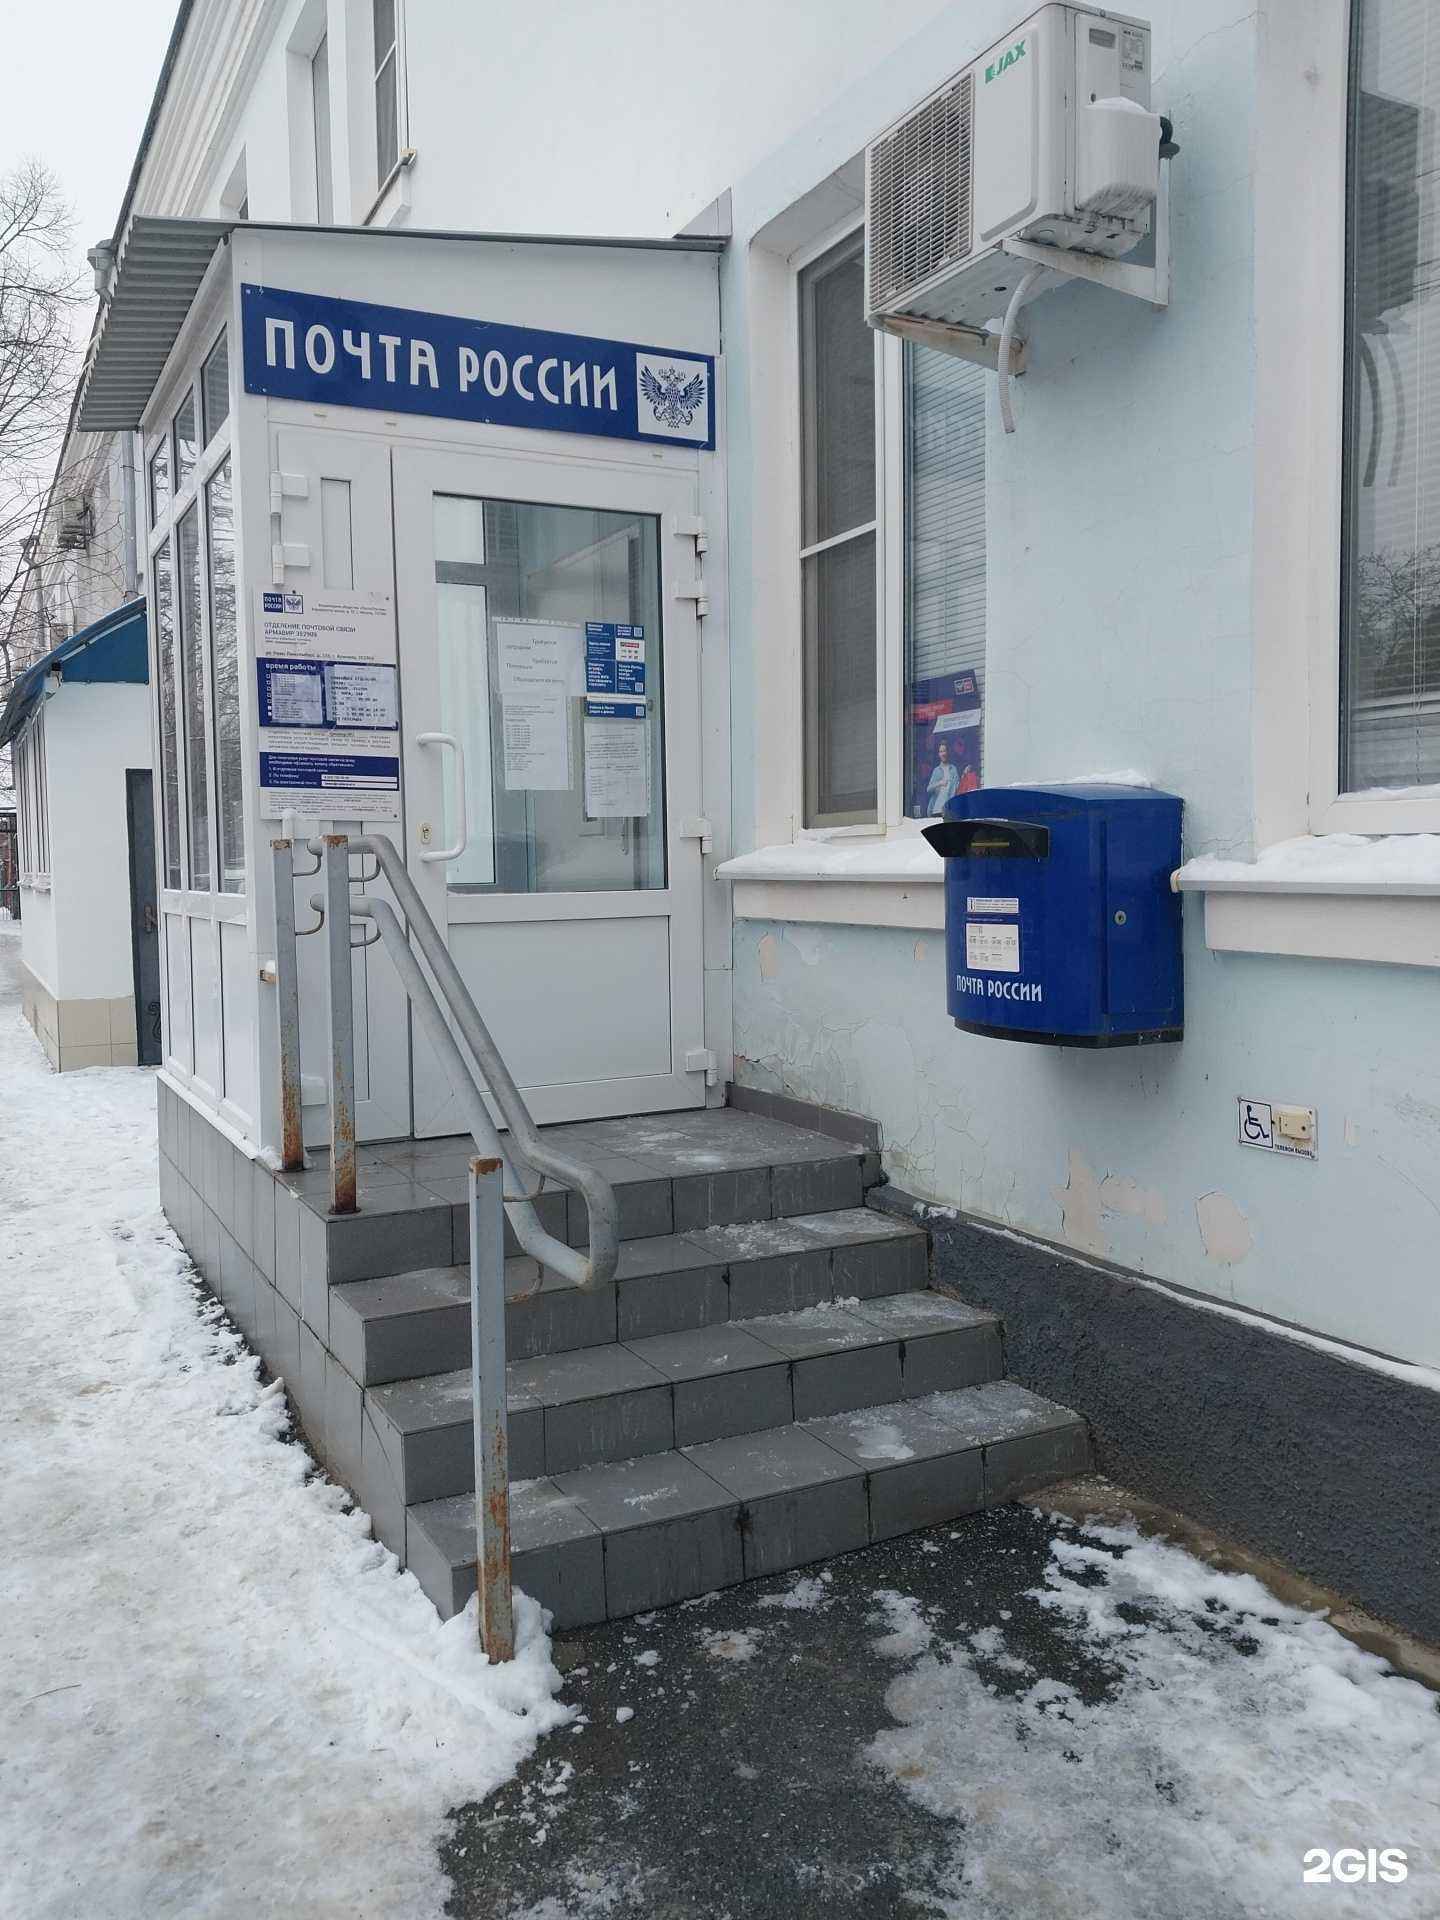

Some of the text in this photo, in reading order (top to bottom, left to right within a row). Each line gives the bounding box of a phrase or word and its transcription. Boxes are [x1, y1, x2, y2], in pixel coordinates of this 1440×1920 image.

[265, 317, 619, 411] ПОЧТА РОССИИ
[264, 622, 301, 630] ОТДЕЛЕНИЕ
[956, 974, 1042, 1002] ПОЧТА РОССИИ
